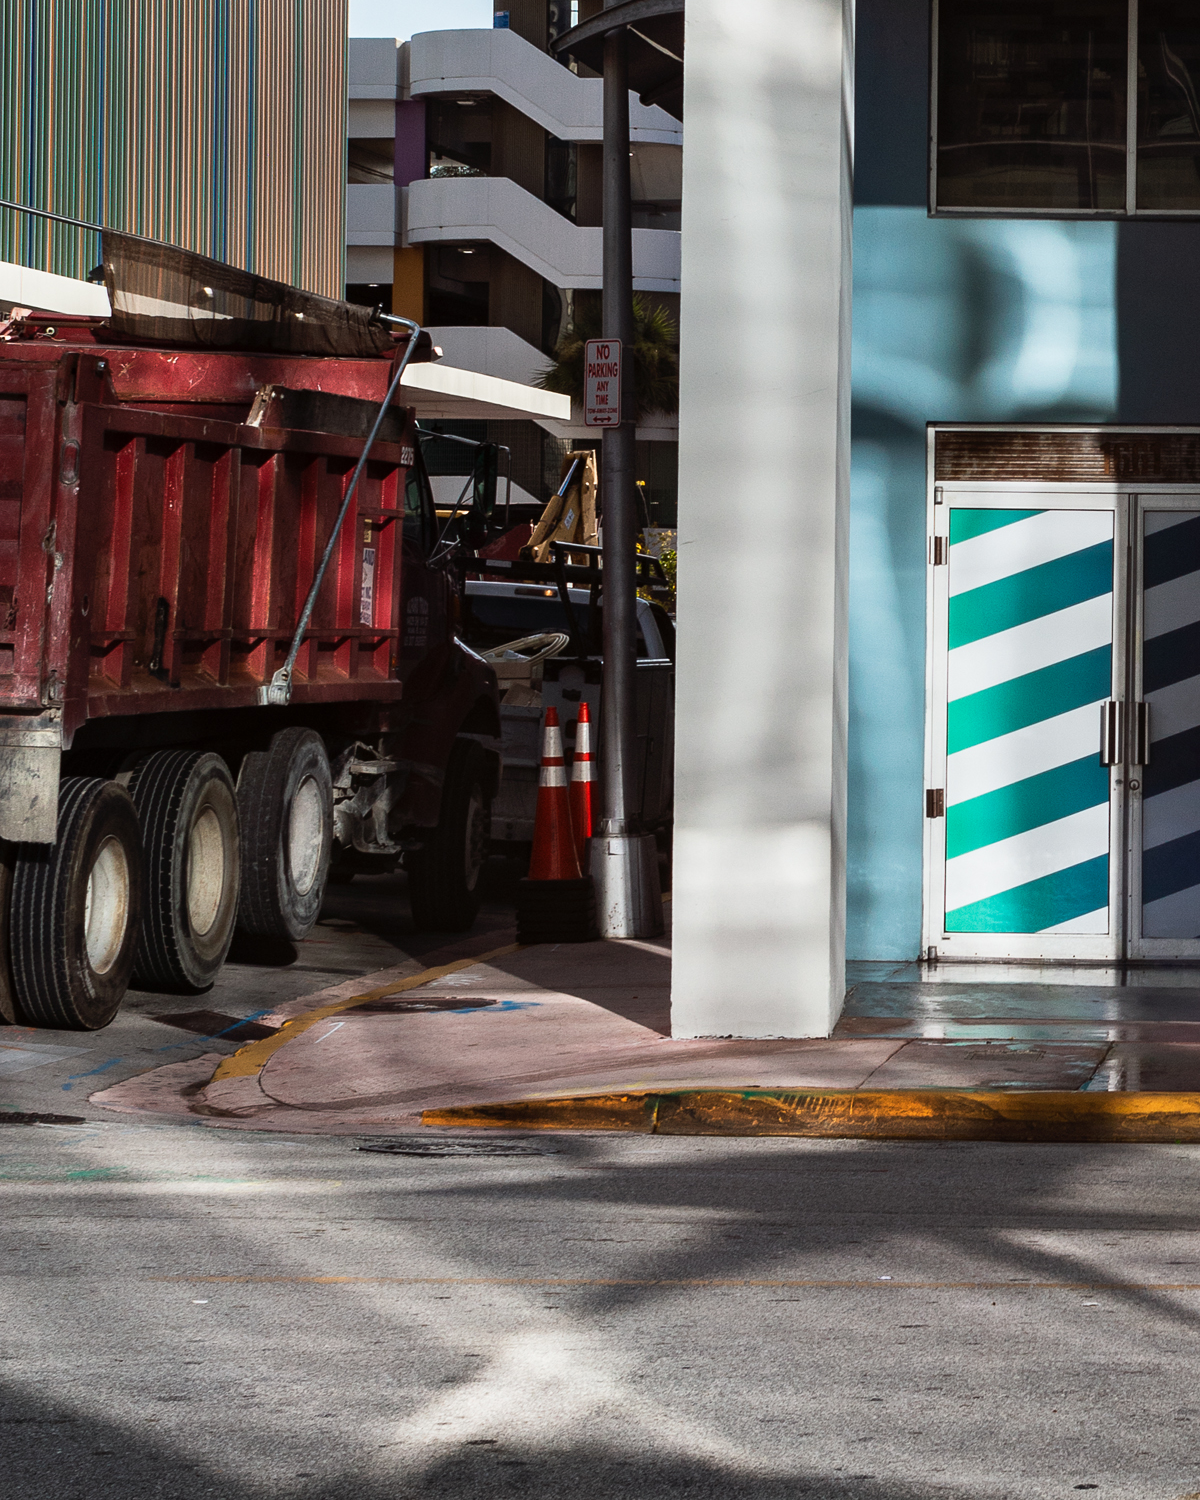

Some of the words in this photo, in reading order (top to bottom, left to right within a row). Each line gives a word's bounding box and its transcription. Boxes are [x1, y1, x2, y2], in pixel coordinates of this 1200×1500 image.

[596, 344, 610, 360] NO
[588, 362, 618, 378] PARKING
[596, 381, 609, 391] ANY
[595, 394, 609, 406] TIME
